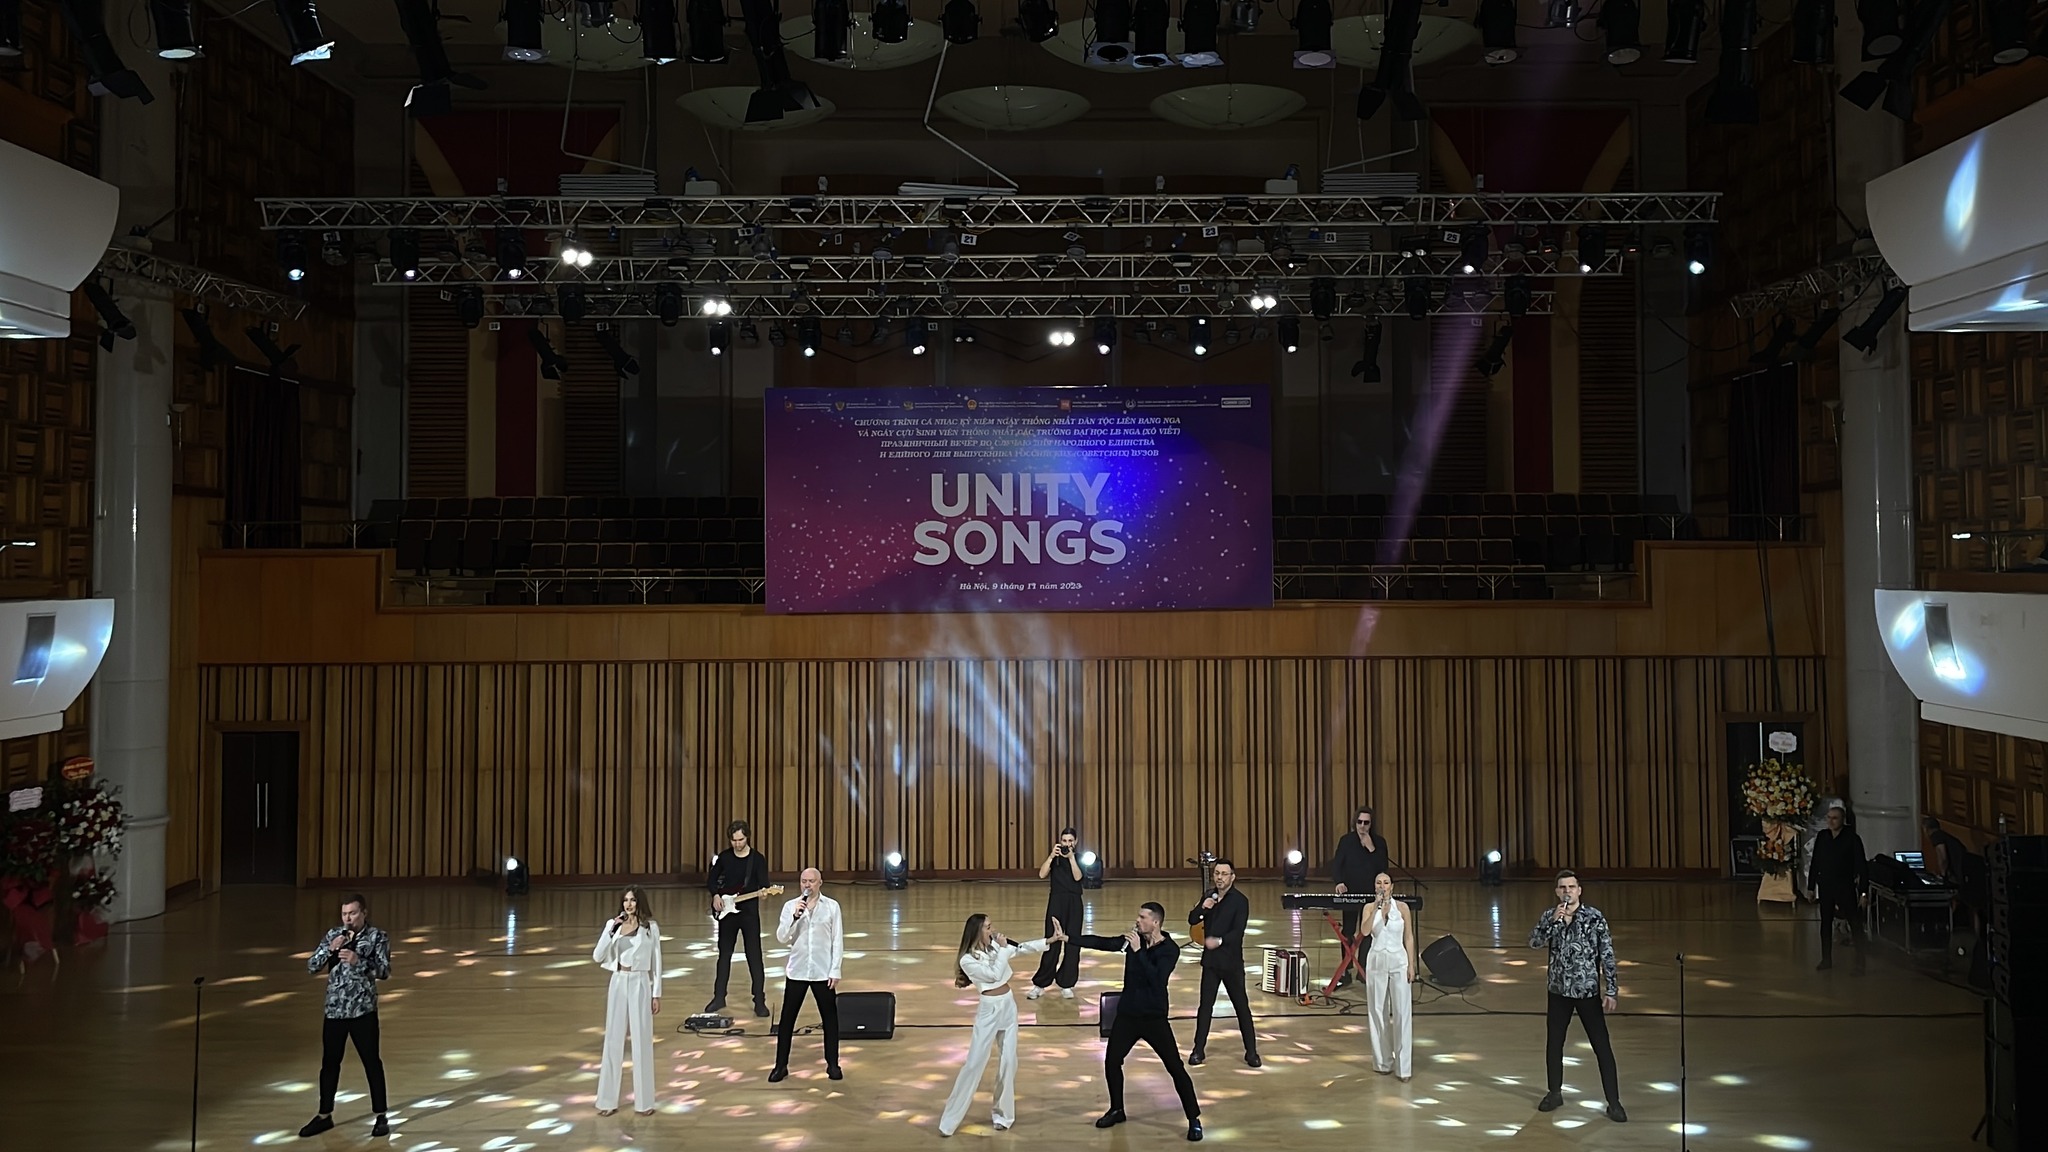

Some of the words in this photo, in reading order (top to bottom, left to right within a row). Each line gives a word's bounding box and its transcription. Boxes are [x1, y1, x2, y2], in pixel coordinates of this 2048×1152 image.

[1205, 227, 1216, 236] 23
[964, 235, 974, 243] 21
[1326, 233, 1335, 241] 24
[1446, 233, 1457, 242] 25
[1097, 416, 1115, 426] TỘC
[1116, 416, 1137, 425] LIÊN
[1138, 417, 1161, 425] BANG
[1163, 417, 1181, 425] NGA
[916, 428, 937, 437] SINH
[1090, 428, 1109, 437] HỌC
[1109, 428, 1122, 436] LB
[1123, 428, 1140, 436] NGA
[880, 439, 949, 448] ПРАЗДНИЧНЫЙ
[950, 439, 979, 448] ВЕЧЕР
[979, 440, 992, 448] ПО
[1054, 439, 1107, 447] НАРОДНОГО
[1108, 439, 1156, 447] ЕДИНСТВА
[879, 450, 887, 458] И
[888, 450, 931, 459] ЕДИНОГО
[932, 450, 952, 458] ДНЯ
[953, 450, 1013, 458] ВЫПУСКНИКА
[1131, 449, 1159, 457] ВУЗОВ
[931, 472, 1111, 517] UNITY
[913, 519, 1127, 566] SONGS
[959, 582, 972, 591] Hà
[973, 582, 990, 592] Nội,
[992, 582, 998, 591] 9
[1000, 581, 1025, 592] tháng
[1039, 582, 1058, 591] năm
[1060, 581, 1081, 591] 2023
